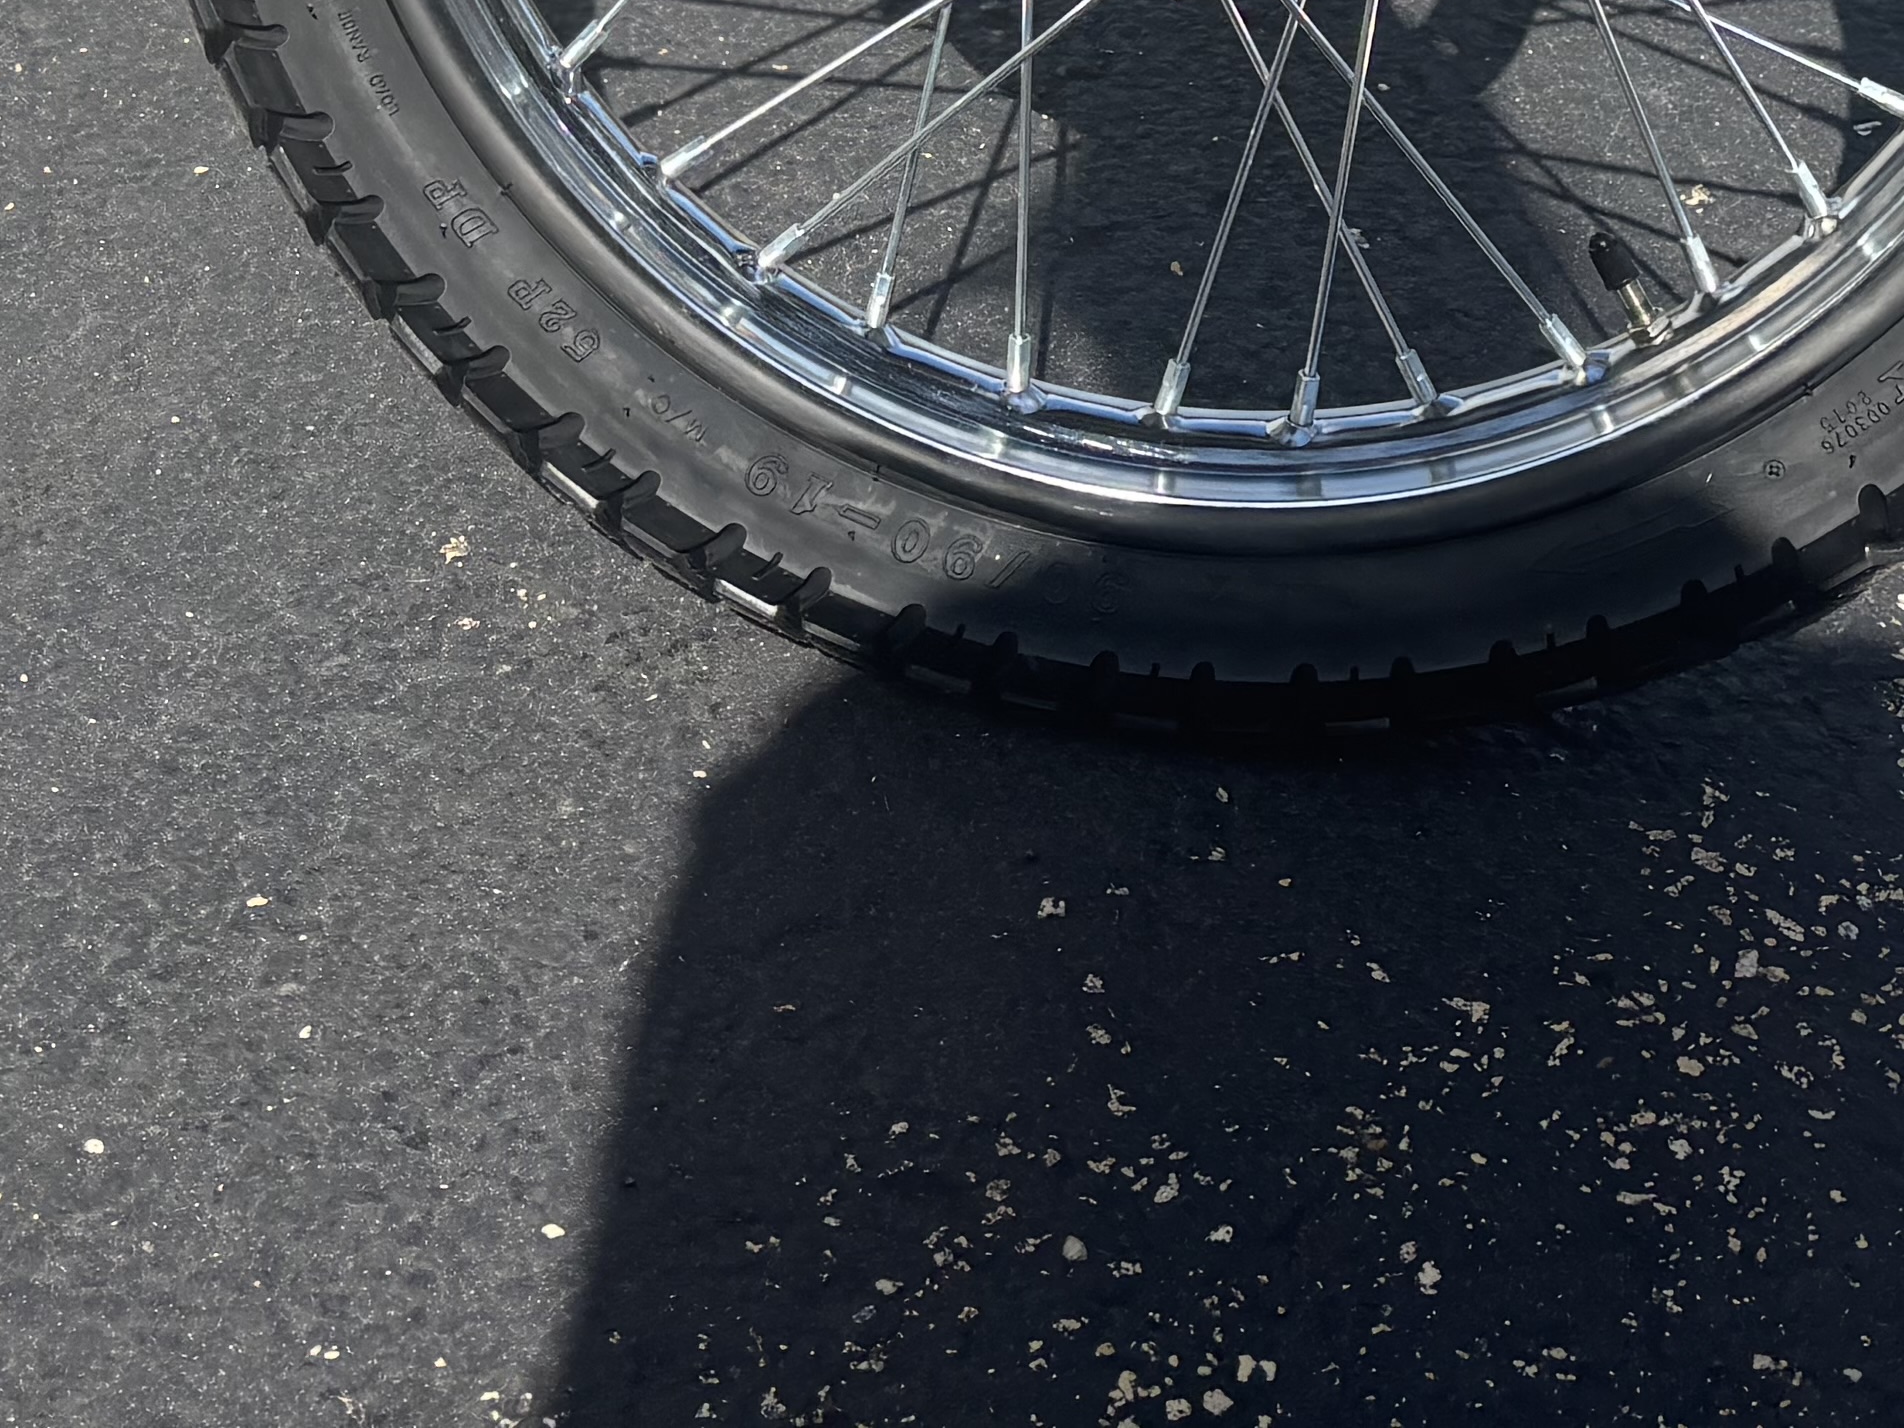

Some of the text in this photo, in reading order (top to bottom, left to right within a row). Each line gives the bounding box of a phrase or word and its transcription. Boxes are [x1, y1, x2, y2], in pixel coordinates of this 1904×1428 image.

[421, 177, 500, 252] DP
[506, 277, 604, 364] 52P
[649, 390, 709, 444] M/C
[1819, 390, 1873, 433] 2015
[1820, 401, 1892, 455] 003076
